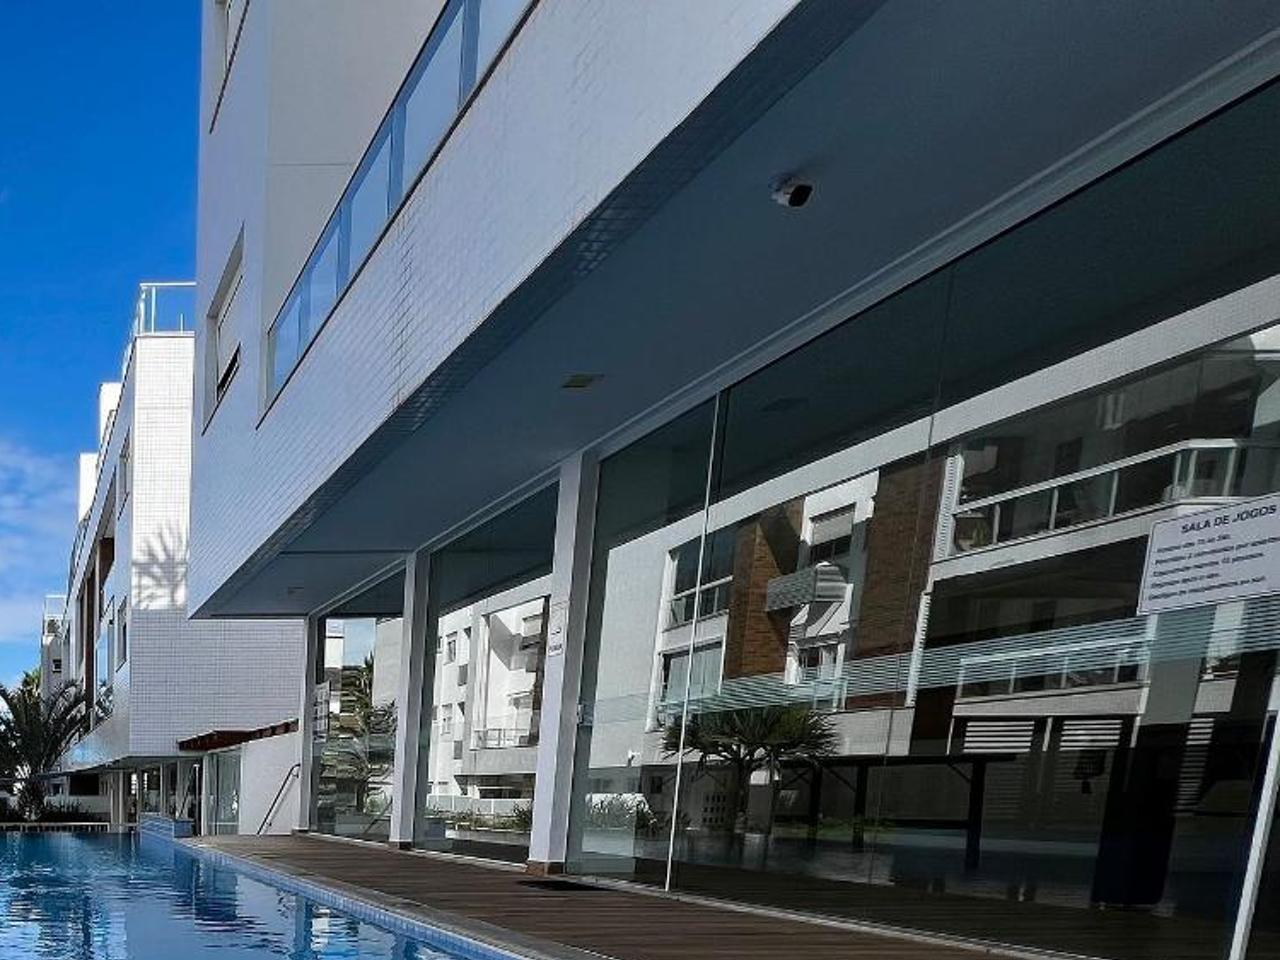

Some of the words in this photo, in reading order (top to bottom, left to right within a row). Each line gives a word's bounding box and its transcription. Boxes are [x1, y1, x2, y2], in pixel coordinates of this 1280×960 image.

[1181, 520, 1211, 534] SALA
[1214, 515, 1230, 526] DE
[1232, 504, 1277, 523] JOGOS
